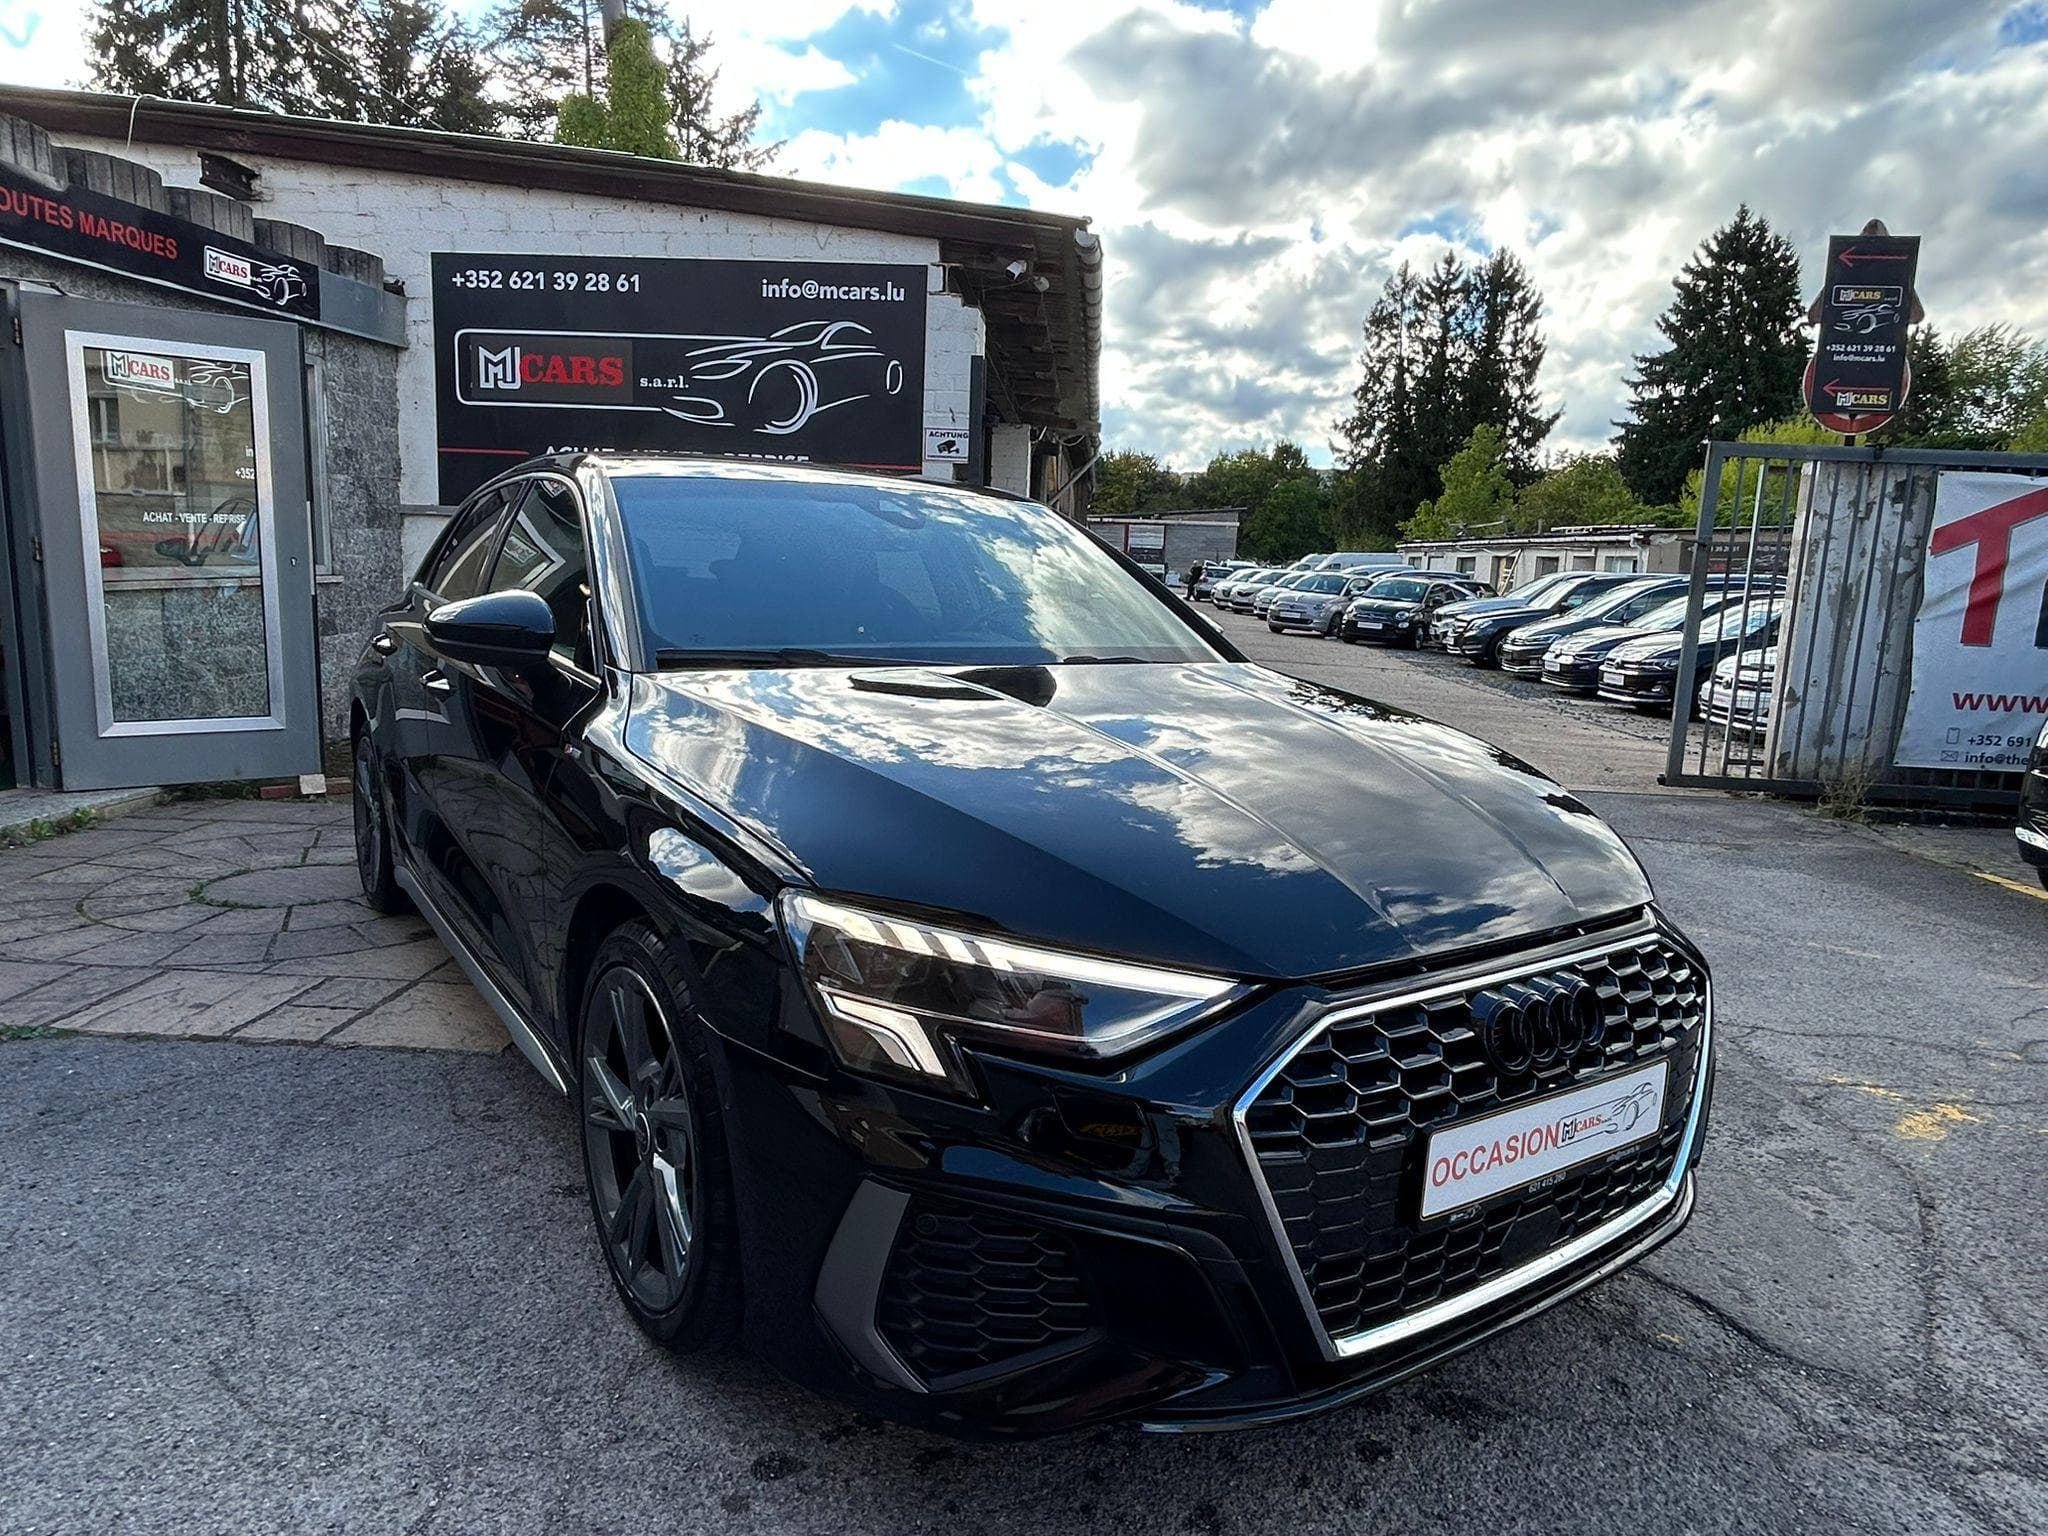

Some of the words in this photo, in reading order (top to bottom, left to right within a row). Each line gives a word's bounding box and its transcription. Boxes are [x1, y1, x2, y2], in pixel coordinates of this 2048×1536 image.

[78, 210, 178, 260] MARQUES
[451, 270, 503, 289] +352
[509, 271, 545, 290] 621
[553, 272, 578, 291] 39
[584, 273, 610, 292] 28
[616, 273, 640, 293] 61
[762, 278, 905, 301] info@mcars.lu
[1847, 344, 1861, 352] 621
[1886, 345, 1896, 353] 61
[639, 375, 689, 388] s.a.r.l.
[929, 431, 969, 439] ACHTUNG
[143, 512, 172, 523] ACHAT
[180, 513, 207, 524] VENTE
[213, 514, 246, 524] REPRISE
[1967, 734, 2002, 747] +352
[2006, 736, 2032, 748] 691
[1432, 1121, 1560, 1188] OCCASION
